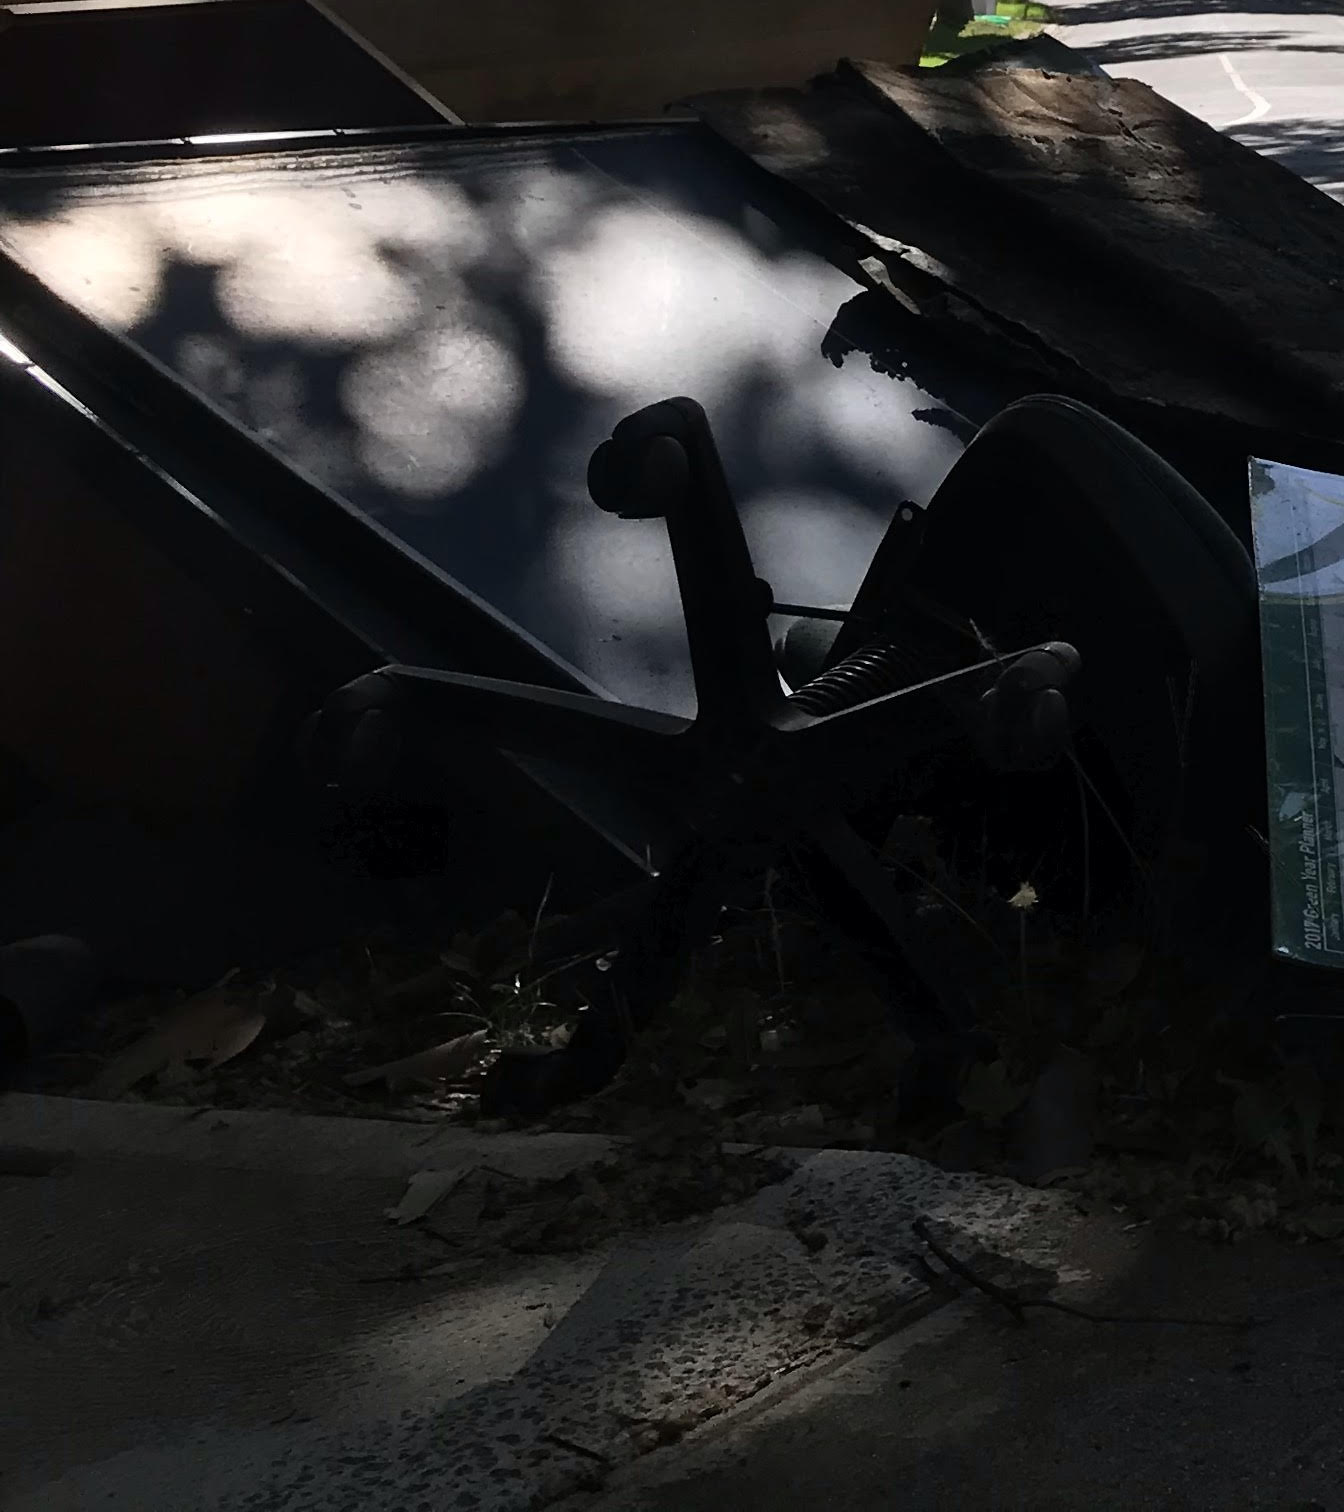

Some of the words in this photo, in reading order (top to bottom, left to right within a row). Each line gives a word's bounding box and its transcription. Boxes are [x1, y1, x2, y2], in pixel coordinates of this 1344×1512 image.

[1298, 811, 1315, 854] Planner
[1300, 855, 1317, 881] Year
[1303, 884, 1319, 919] Green
[1305, 920, 1323, 950] 2017
